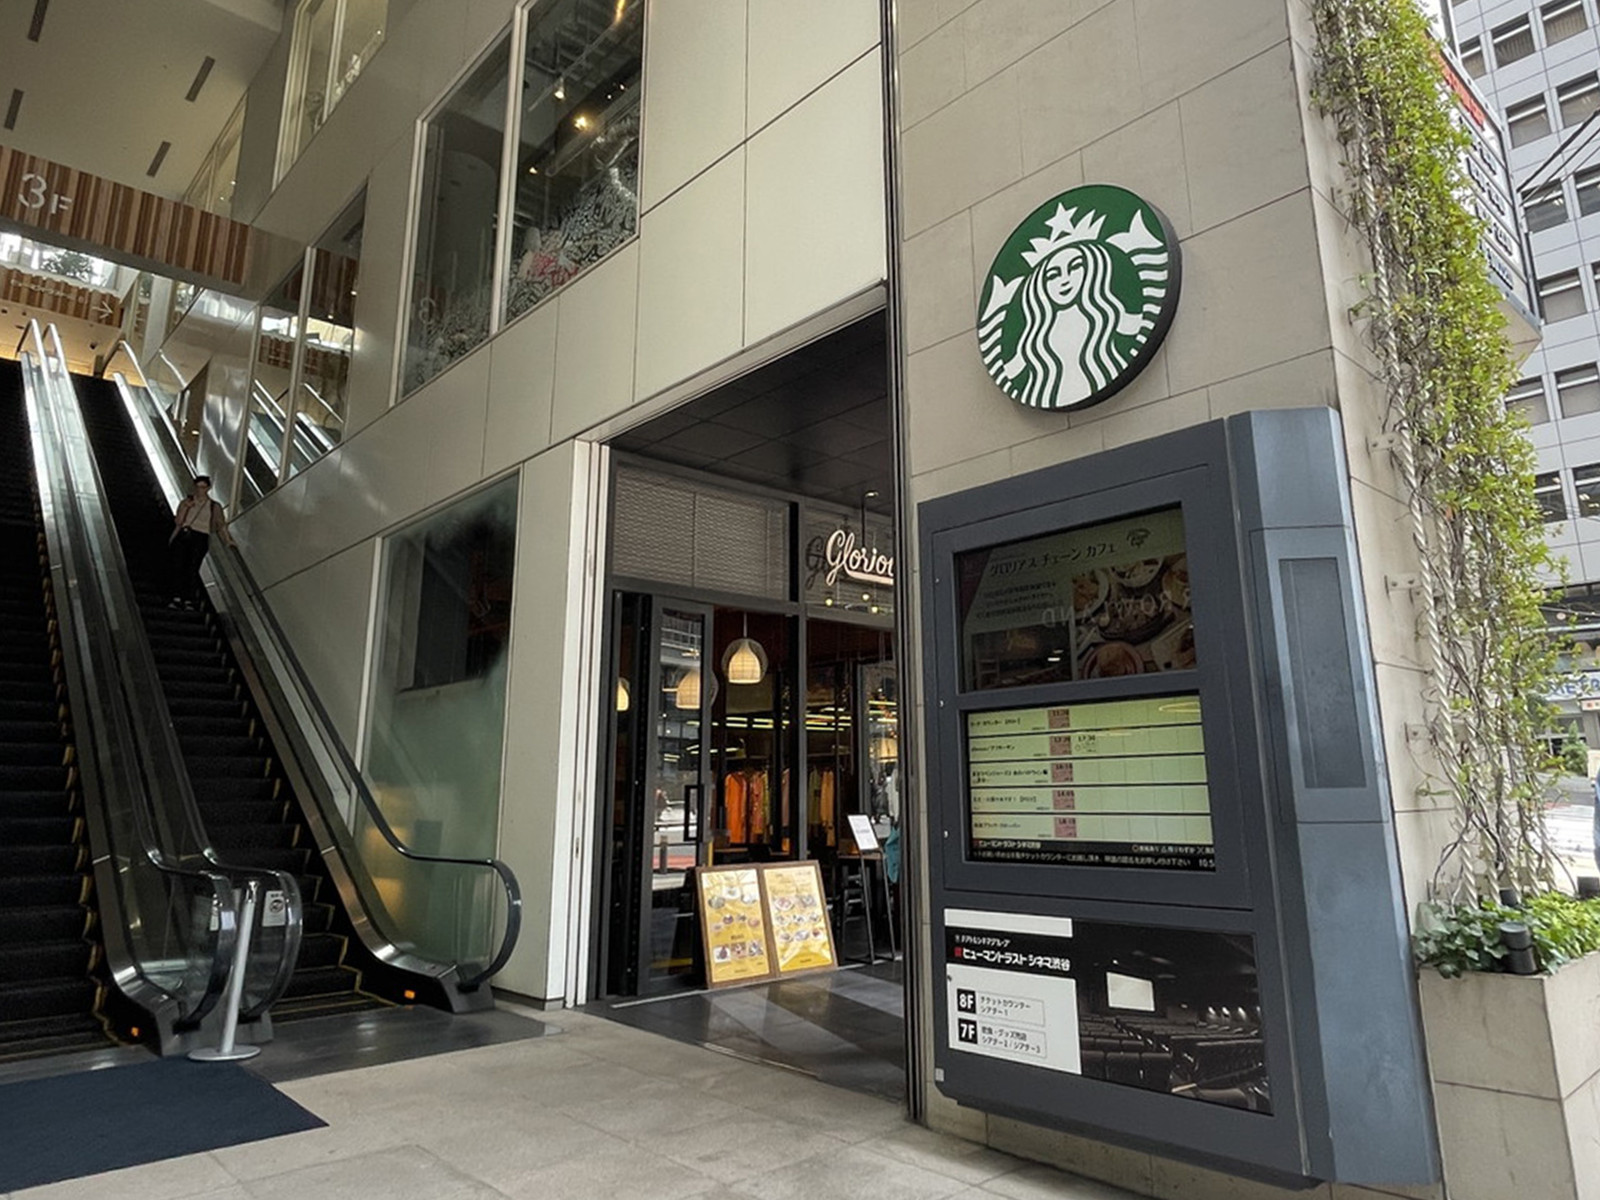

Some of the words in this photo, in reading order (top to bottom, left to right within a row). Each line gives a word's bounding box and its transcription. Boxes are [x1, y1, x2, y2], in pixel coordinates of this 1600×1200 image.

[18, 172, 73, 215] 3F
[959, 993, 974, 1009] 8F
[960, 1023, 975, 1040] 7F
